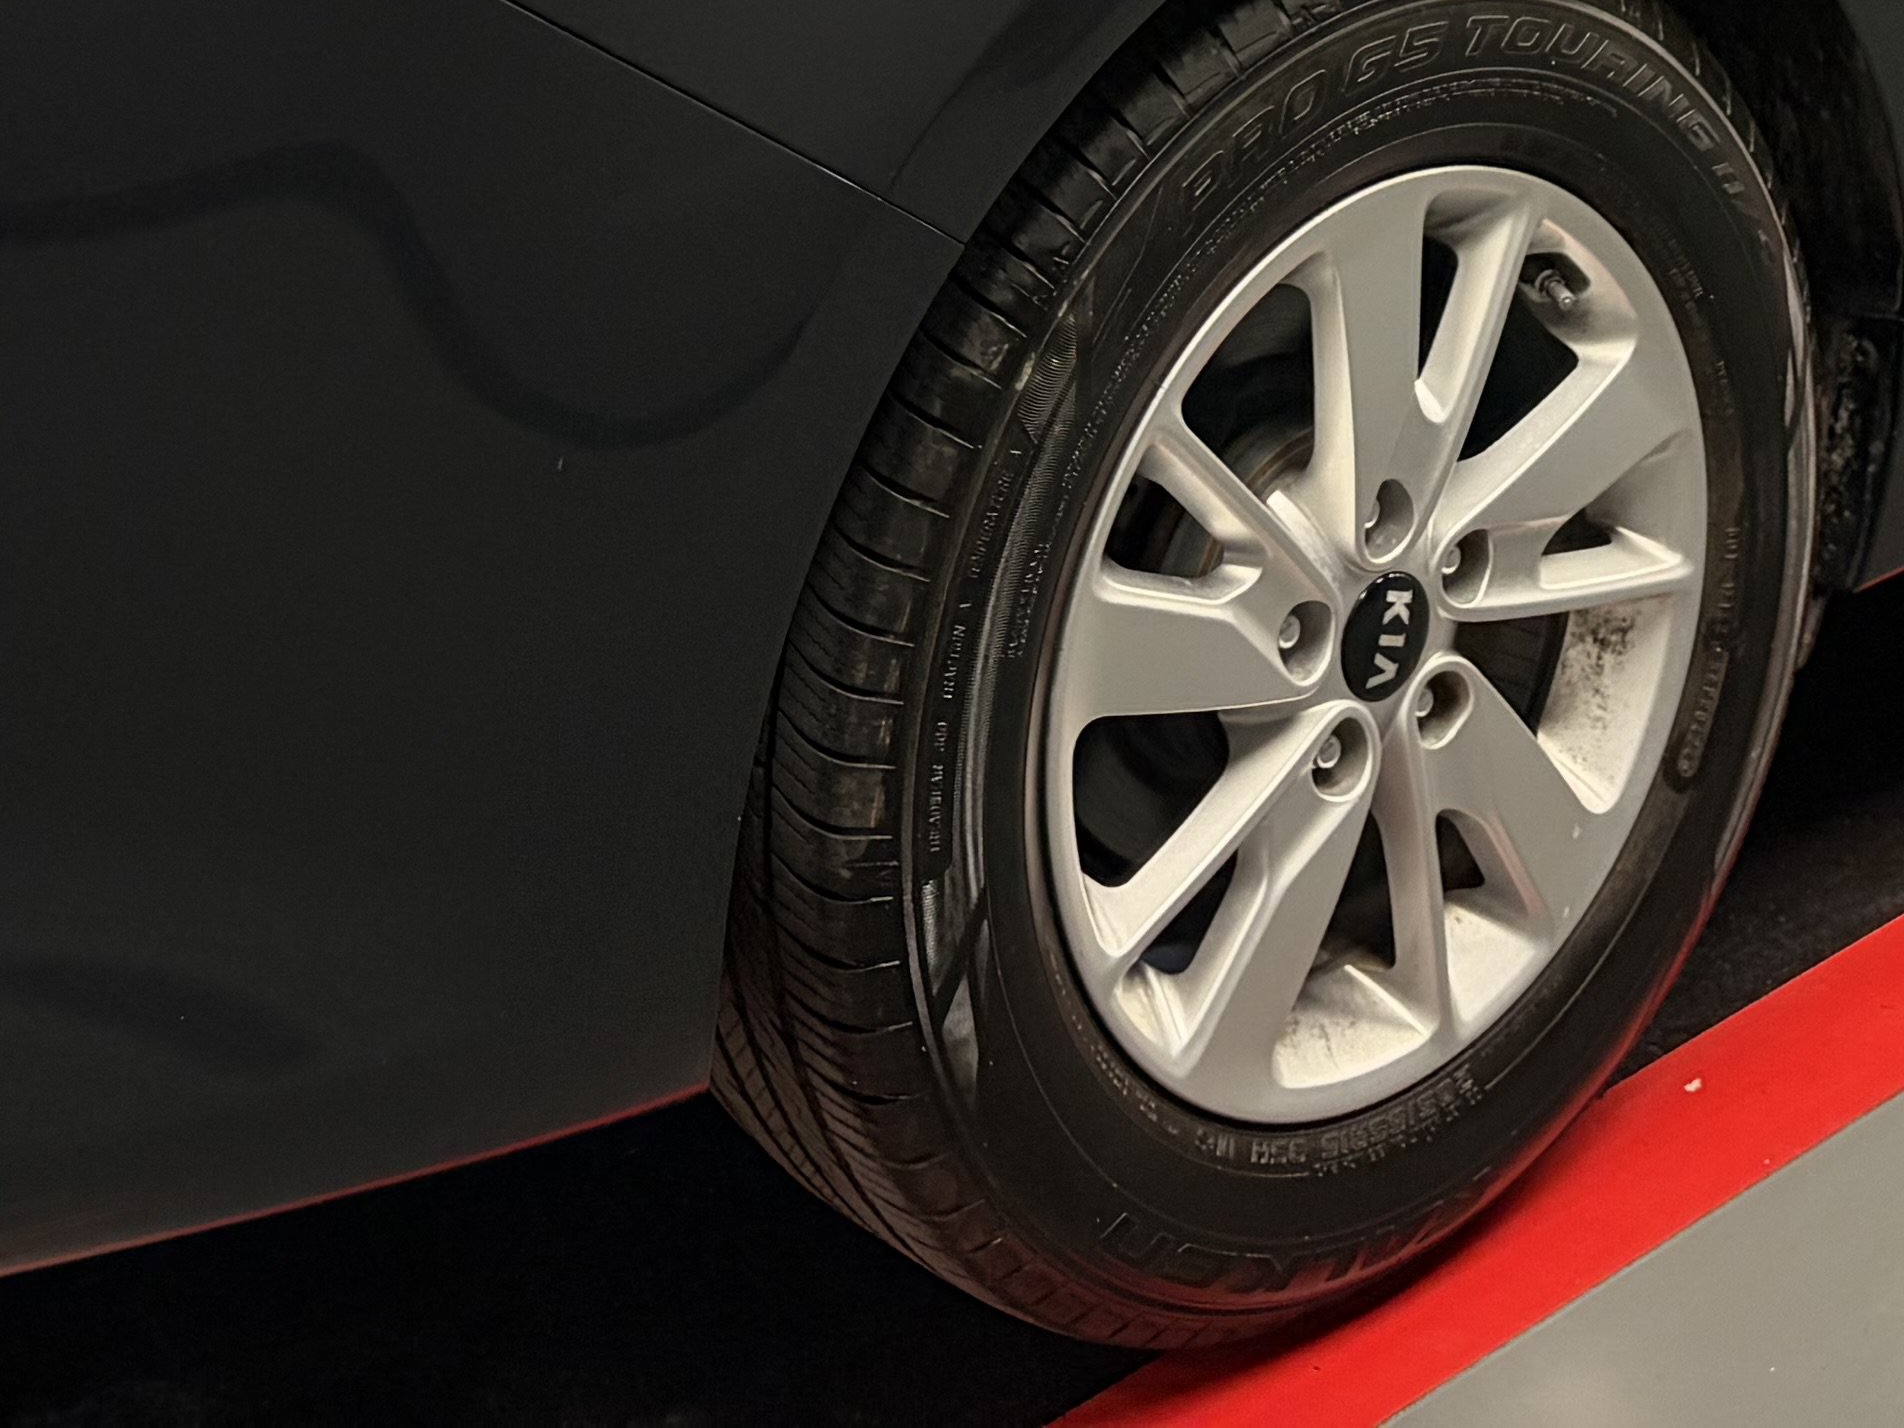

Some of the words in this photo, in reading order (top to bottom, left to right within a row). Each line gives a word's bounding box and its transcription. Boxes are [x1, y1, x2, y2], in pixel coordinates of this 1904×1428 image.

[1343, 20, 1450, 90] G5
[1464, 15, 1721, 152] TOURING
[1365, 590, 1414, 689] KIA
